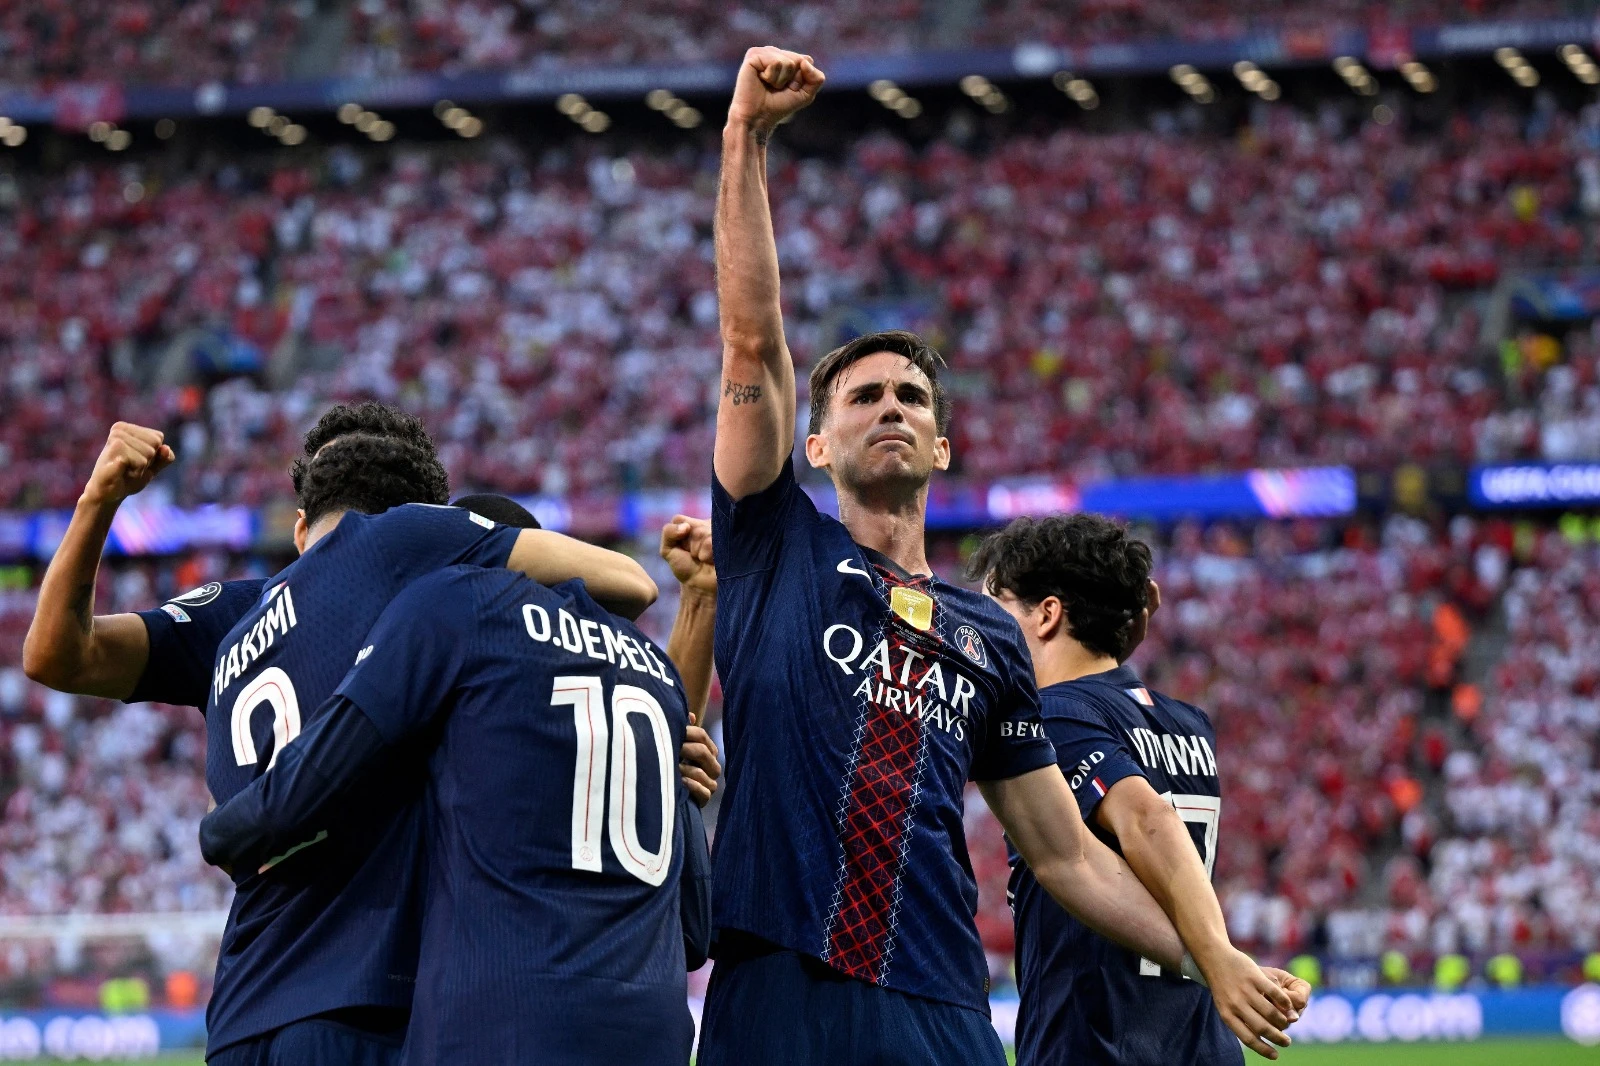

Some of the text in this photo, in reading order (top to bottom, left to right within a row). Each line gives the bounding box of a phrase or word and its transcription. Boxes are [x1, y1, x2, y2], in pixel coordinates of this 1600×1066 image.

[213, 585, 298, 706] HAKIMI
[823, 624, 976, 718] QATAR
[960, 627, 981, 645] PARIS
[853, 676, 968, 742] AIRWAYS
[550, 675, 675, 887] 10
